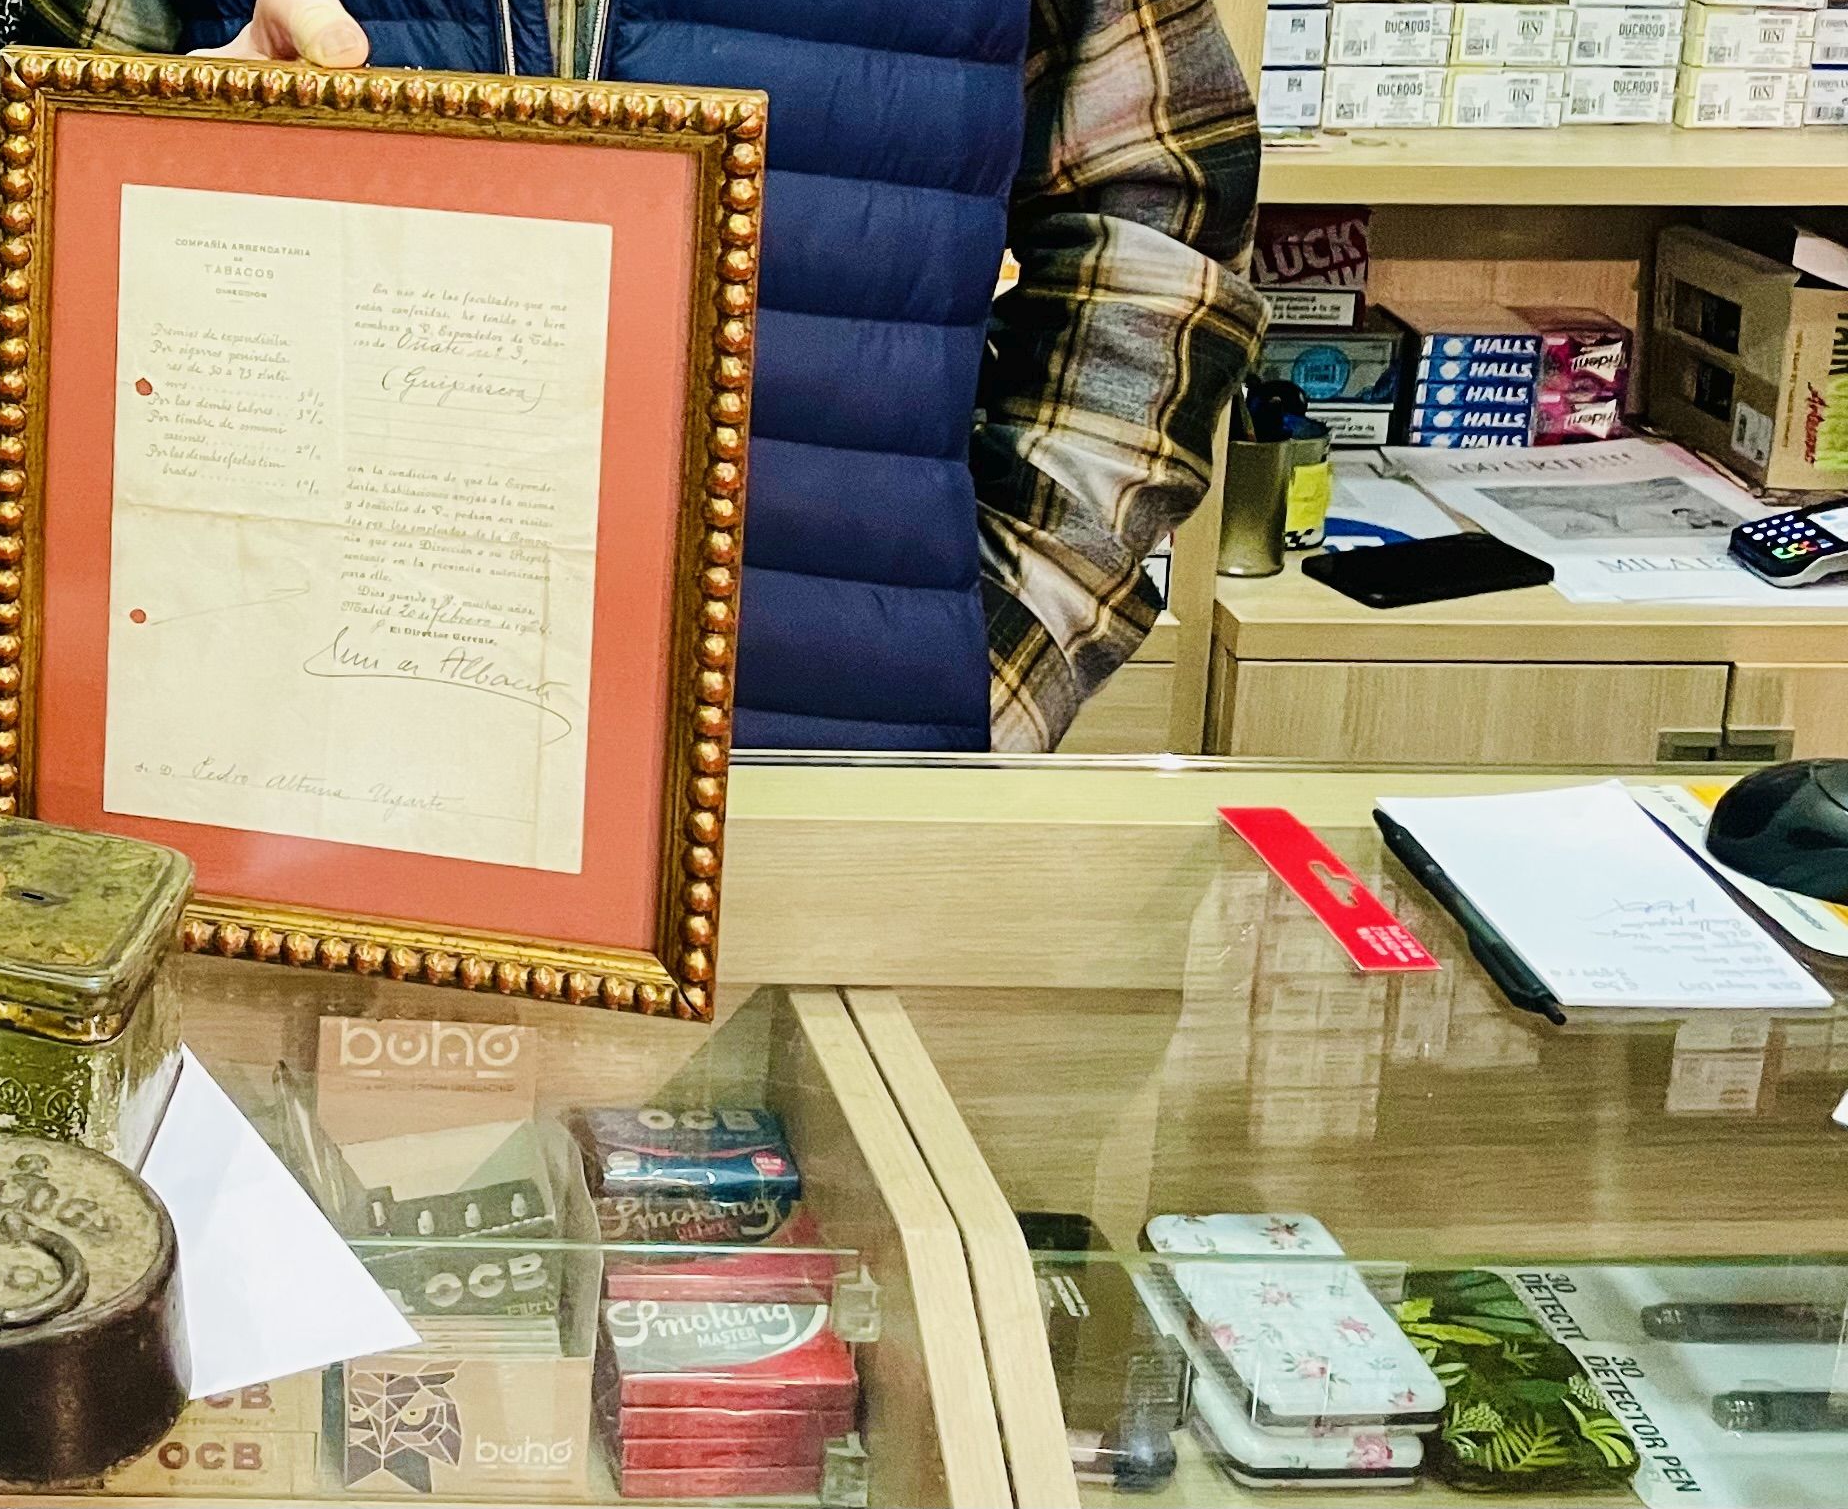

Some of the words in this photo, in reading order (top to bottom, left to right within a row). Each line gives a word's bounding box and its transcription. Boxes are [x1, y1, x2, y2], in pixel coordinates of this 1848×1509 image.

[1385, 19, 1430, 33] DUCADOS
[204, 265, 275, 280] TABACOS
[1472, 339, 1535, 355] HALLS
[1469, 362, 1532, 379] HALLS
[1466, 387, 1529, 404] HALLS
[1463, 411, 1525, 428] HALLS
[637, 1108, 760, 1132] OCB
[425, 1254, 549, 1304] OCB
[607, 1301, 797, 1347] Smoking
[158, 1441, 265, 1471] OCB
[1658, 1449, 1702, 1494] PEN
